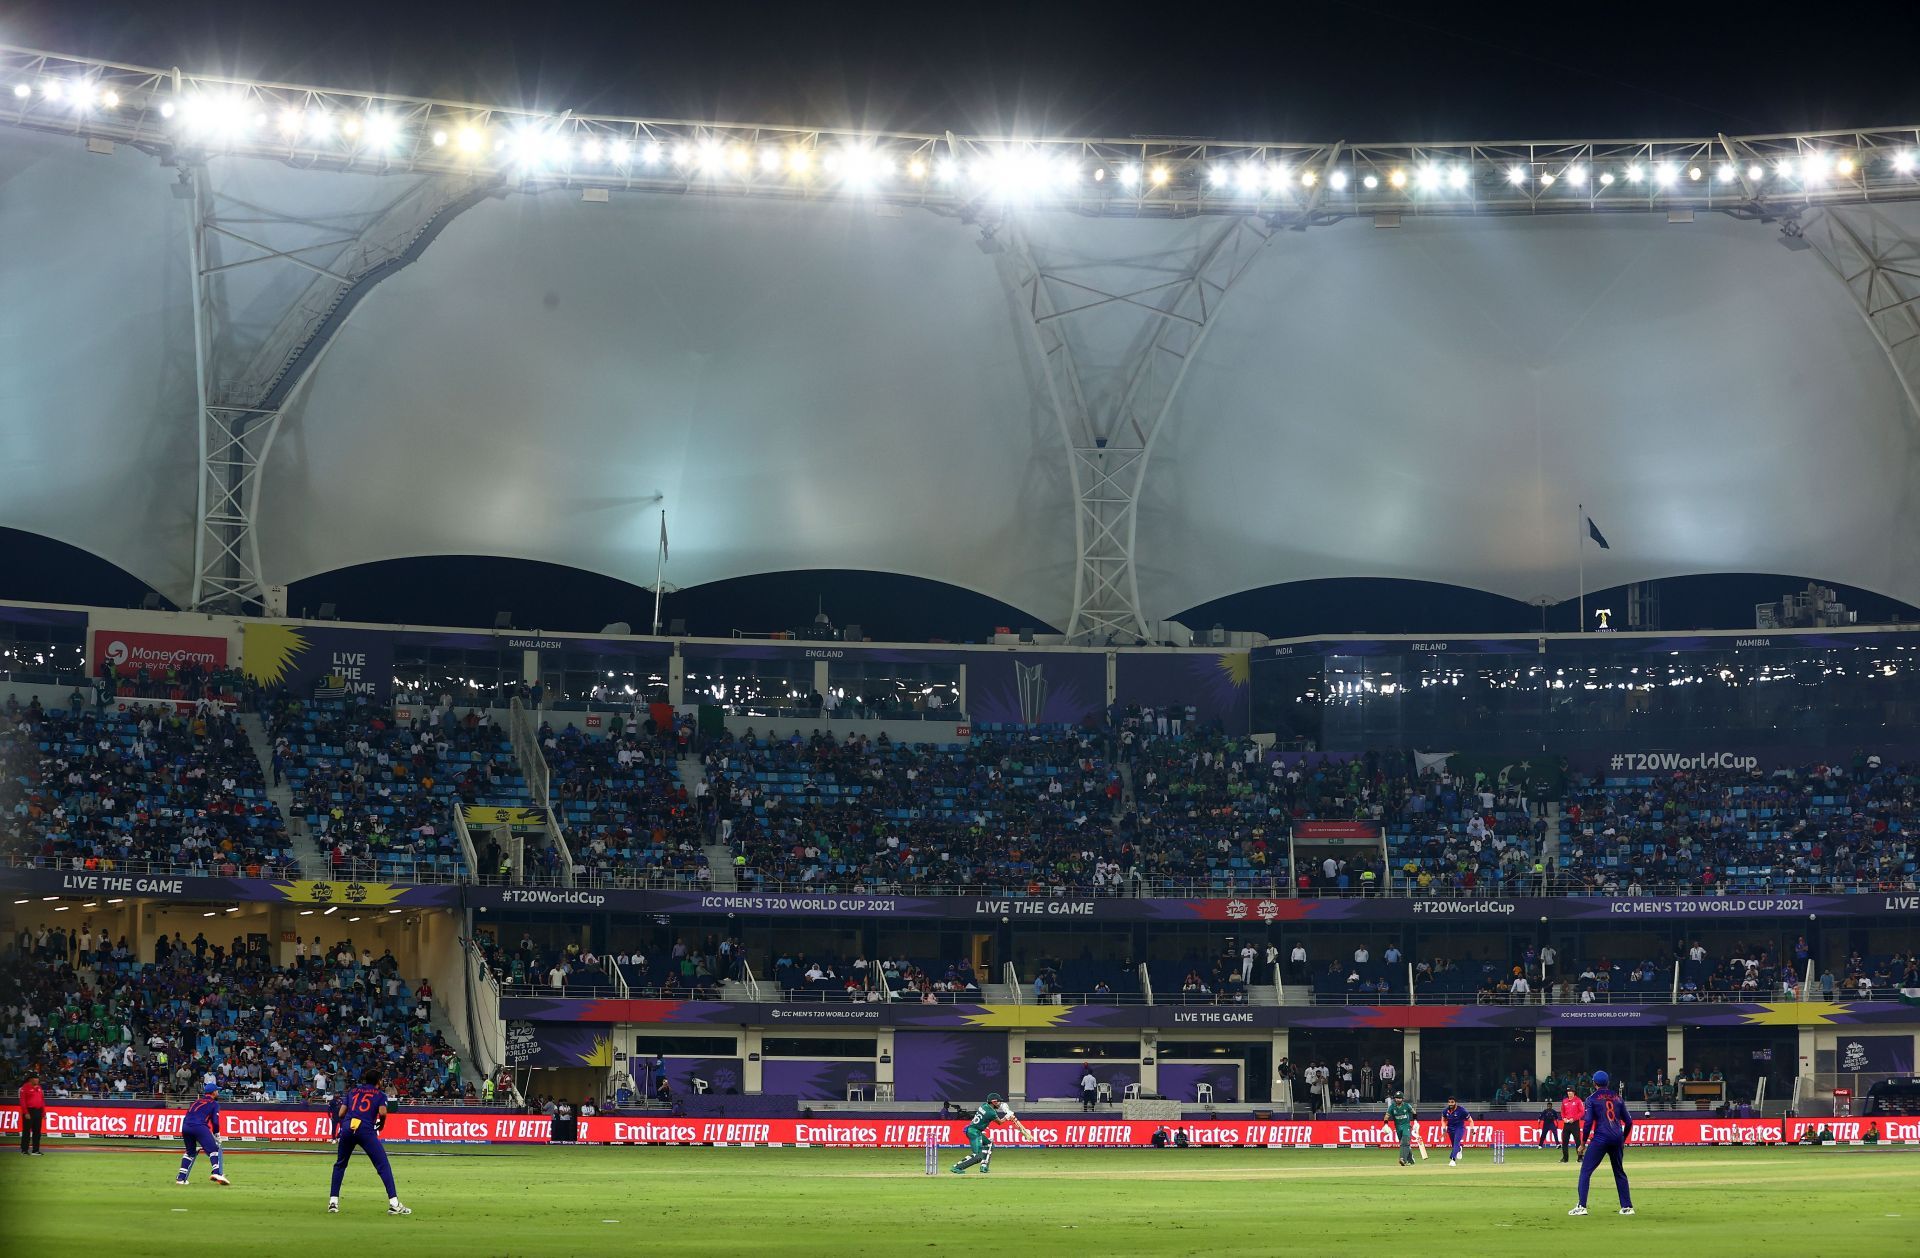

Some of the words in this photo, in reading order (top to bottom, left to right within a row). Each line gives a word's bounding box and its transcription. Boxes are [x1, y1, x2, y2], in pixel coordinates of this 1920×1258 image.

[509, 640, 562, 649] BANGLADESH
[1275, 647, 1293, 655] INDIA
[1412, 643, 1447, 651] IRELAND
[1736, 639, 1770, 647] NAMIBIA
[132, 646, 214, 664] MoneyGram
[333, 652, 366, 665] LIVE
[805, 650, 843, 658] ENGLAND
[332, 667, 360, 680] THE
[344, 682, 376, 695] AME
[1610, 752, 1758, 772] #T20WorldCup
[63, 876, 98, 889] LIVE
[102, 878, 132, 891] THE
[136, 879, 182, 894] GAME
[502, 890, 605, 906] #T20WorldCup
[702, 897, 722, 908] ICC
[725, 897, 763, 908] MEN'S
[765, 899, 788, 909] T20
[790, 899, 837, 910] WORLD
[840, 900, 865, 911] CUP
[868, 901, 895, 911] 2021
[1885, 897, 1920, 910] LIVE
[976, 901, 1010, 913] LIVE
[1014, 902, 1044, 914] THE
[1048, 902, 1094, 914] GAME
[1413, 901, 1515, 915] #T20WorldCup
[1611, 903, 1631, 913] ICC
[1633, 902, 1672, 913] MEN'S
[1674, 902, 1696, 912] T20
[1698, 901, 1746, 912] WORLD
[1748, 900, 1773, 911] CUP
[1776, 900, 1804, 910] 2021
[825, 1011, 850, 1019] WORLD
[1174, 1013, 1198, 1022] LIVE
[1200, 1013, 1220, 1022] THE
[1222, 1013, 1254, 1022] GAME
[352, 1093, 374, 1112] 15
[1606, 1101, 1615, 1121] 8
[0, 1111, 19, 1129] TER
[46, 1112, 126, 1132] Emirates
[134, 1114, 154, 1132] FLY
[156, 1115, 183, 1133] BETT
[226, 1116, 308, 1135] Emirates
[406, 1118, 488, 1137] Emirates
[496, 1120, 516, 1138] FLY
[518, 1120, 552, 1138] BETTE
[615, 1122, 696, 1141] Emirates
[703, 1124, 724, 1141] FLY
[726, 1124, 770, 1141] BETTER
[796, 1124, 876, 1142] Emirates
[884, 1126, 905, 1142] FLY
[907, 1126, 950, 1142] BETTER
[989, 1125, 1058, 1142] mirates
[1066, 1126, 1086, 1142] FLY
[1088, 1126, 1131, 1142] BETTER
[1246, 1126, 1266, 1142] FLY
[1269, 1126, 1312, 1142] BETTER
[1631, 1125, 1674, 1141] BETTER
[1700, 1124, 1782, 1141] Emirates
